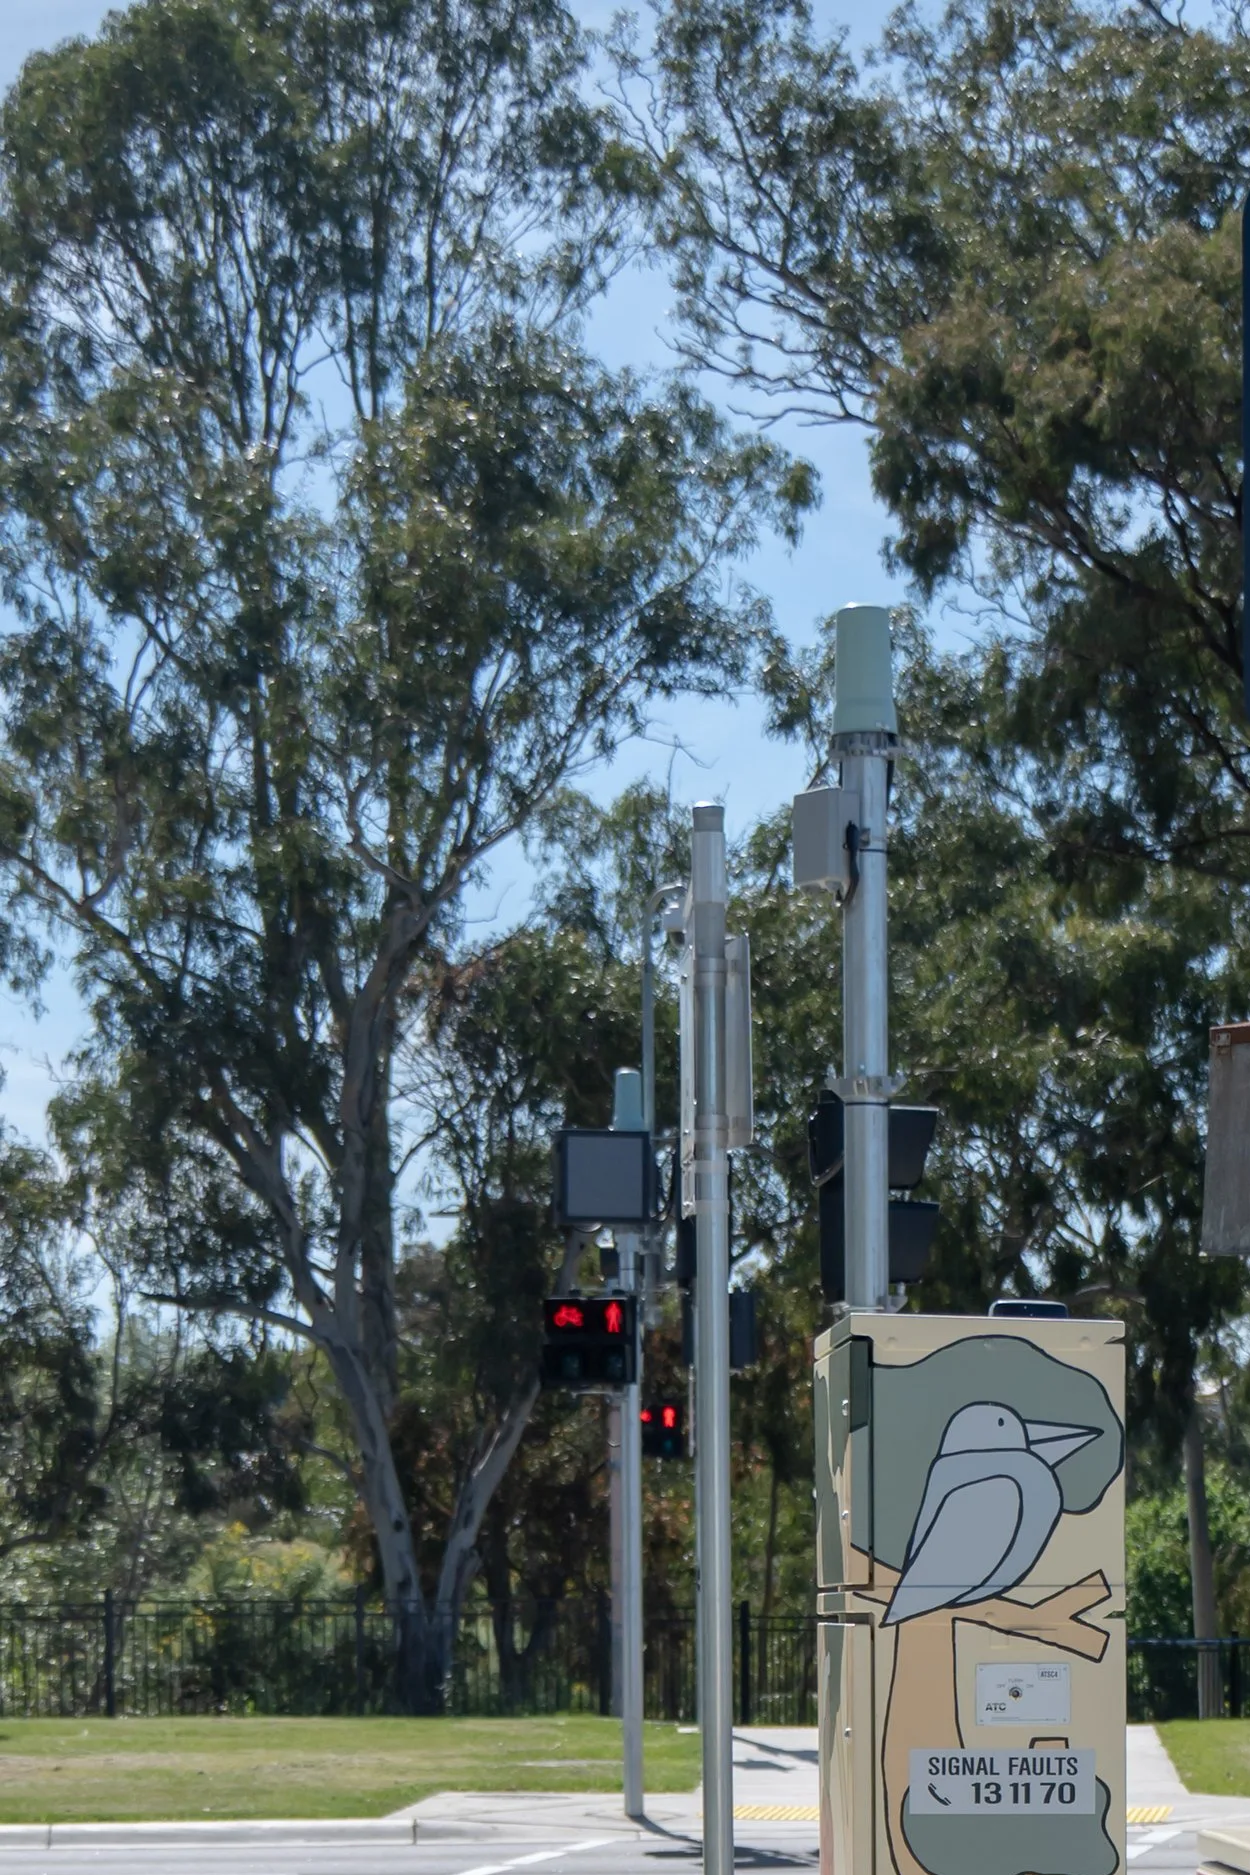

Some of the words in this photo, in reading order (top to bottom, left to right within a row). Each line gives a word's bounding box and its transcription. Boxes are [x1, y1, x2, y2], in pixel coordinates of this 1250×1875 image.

[985, 1702, 1007, 1712] ATC
[928, 1756, 1000, 1776] SIGNAL
[1008, 1756, 1079, 1776] FAULTS
[971, 1782, 1002, 1805] 13
[1009, 1782, 1031, 1805] 11
[1040, 1782, 1076, 1805] 70
